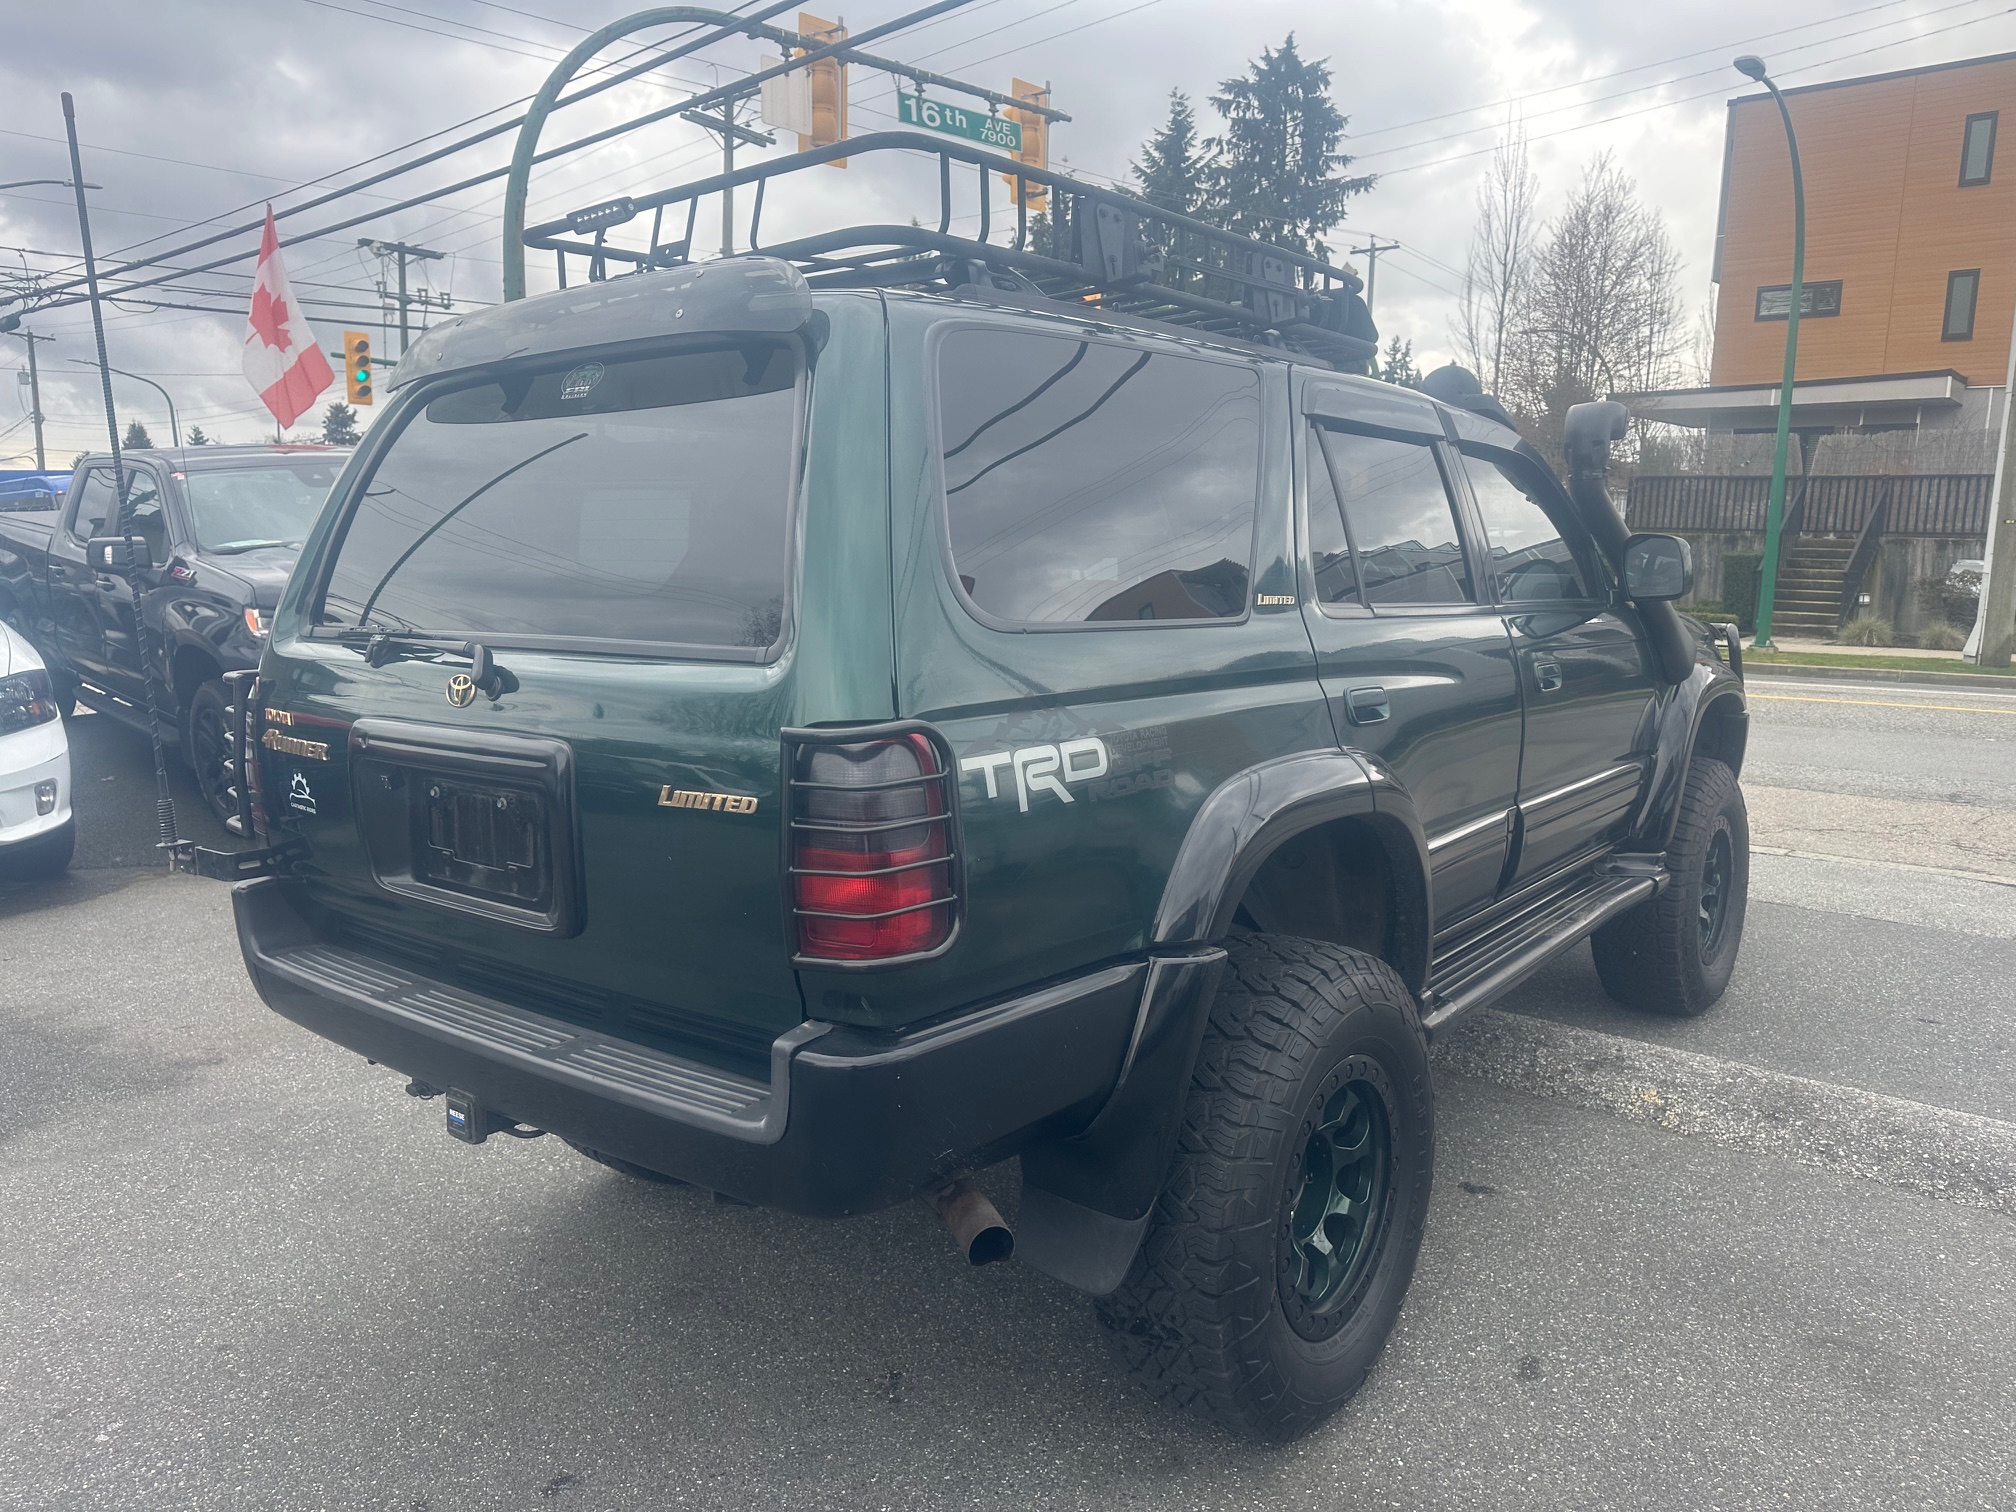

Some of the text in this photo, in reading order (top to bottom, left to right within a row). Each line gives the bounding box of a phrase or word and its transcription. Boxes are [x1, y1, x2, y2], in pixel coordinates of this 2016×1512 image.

[904, 97, 1011, 135] 16th AVE
[979, 128, 1016, 147] 7900
[171, 566, 197, 581] Z71
[1257, 593, 1295, 606] LIMITED
[264, 707, 294, 726] TOYOTA
[1108, 725, 1168, 743] TOYOTA RACING
[1111, 736, 1169, 755] DEVELOPMENT
[960, 737, 1108, 813] TRD
[1087, 769, 1175, 804] ROAD
[657, 784, 759, 815] LIMITED
[449, 1108, 466, 1121] REESE
